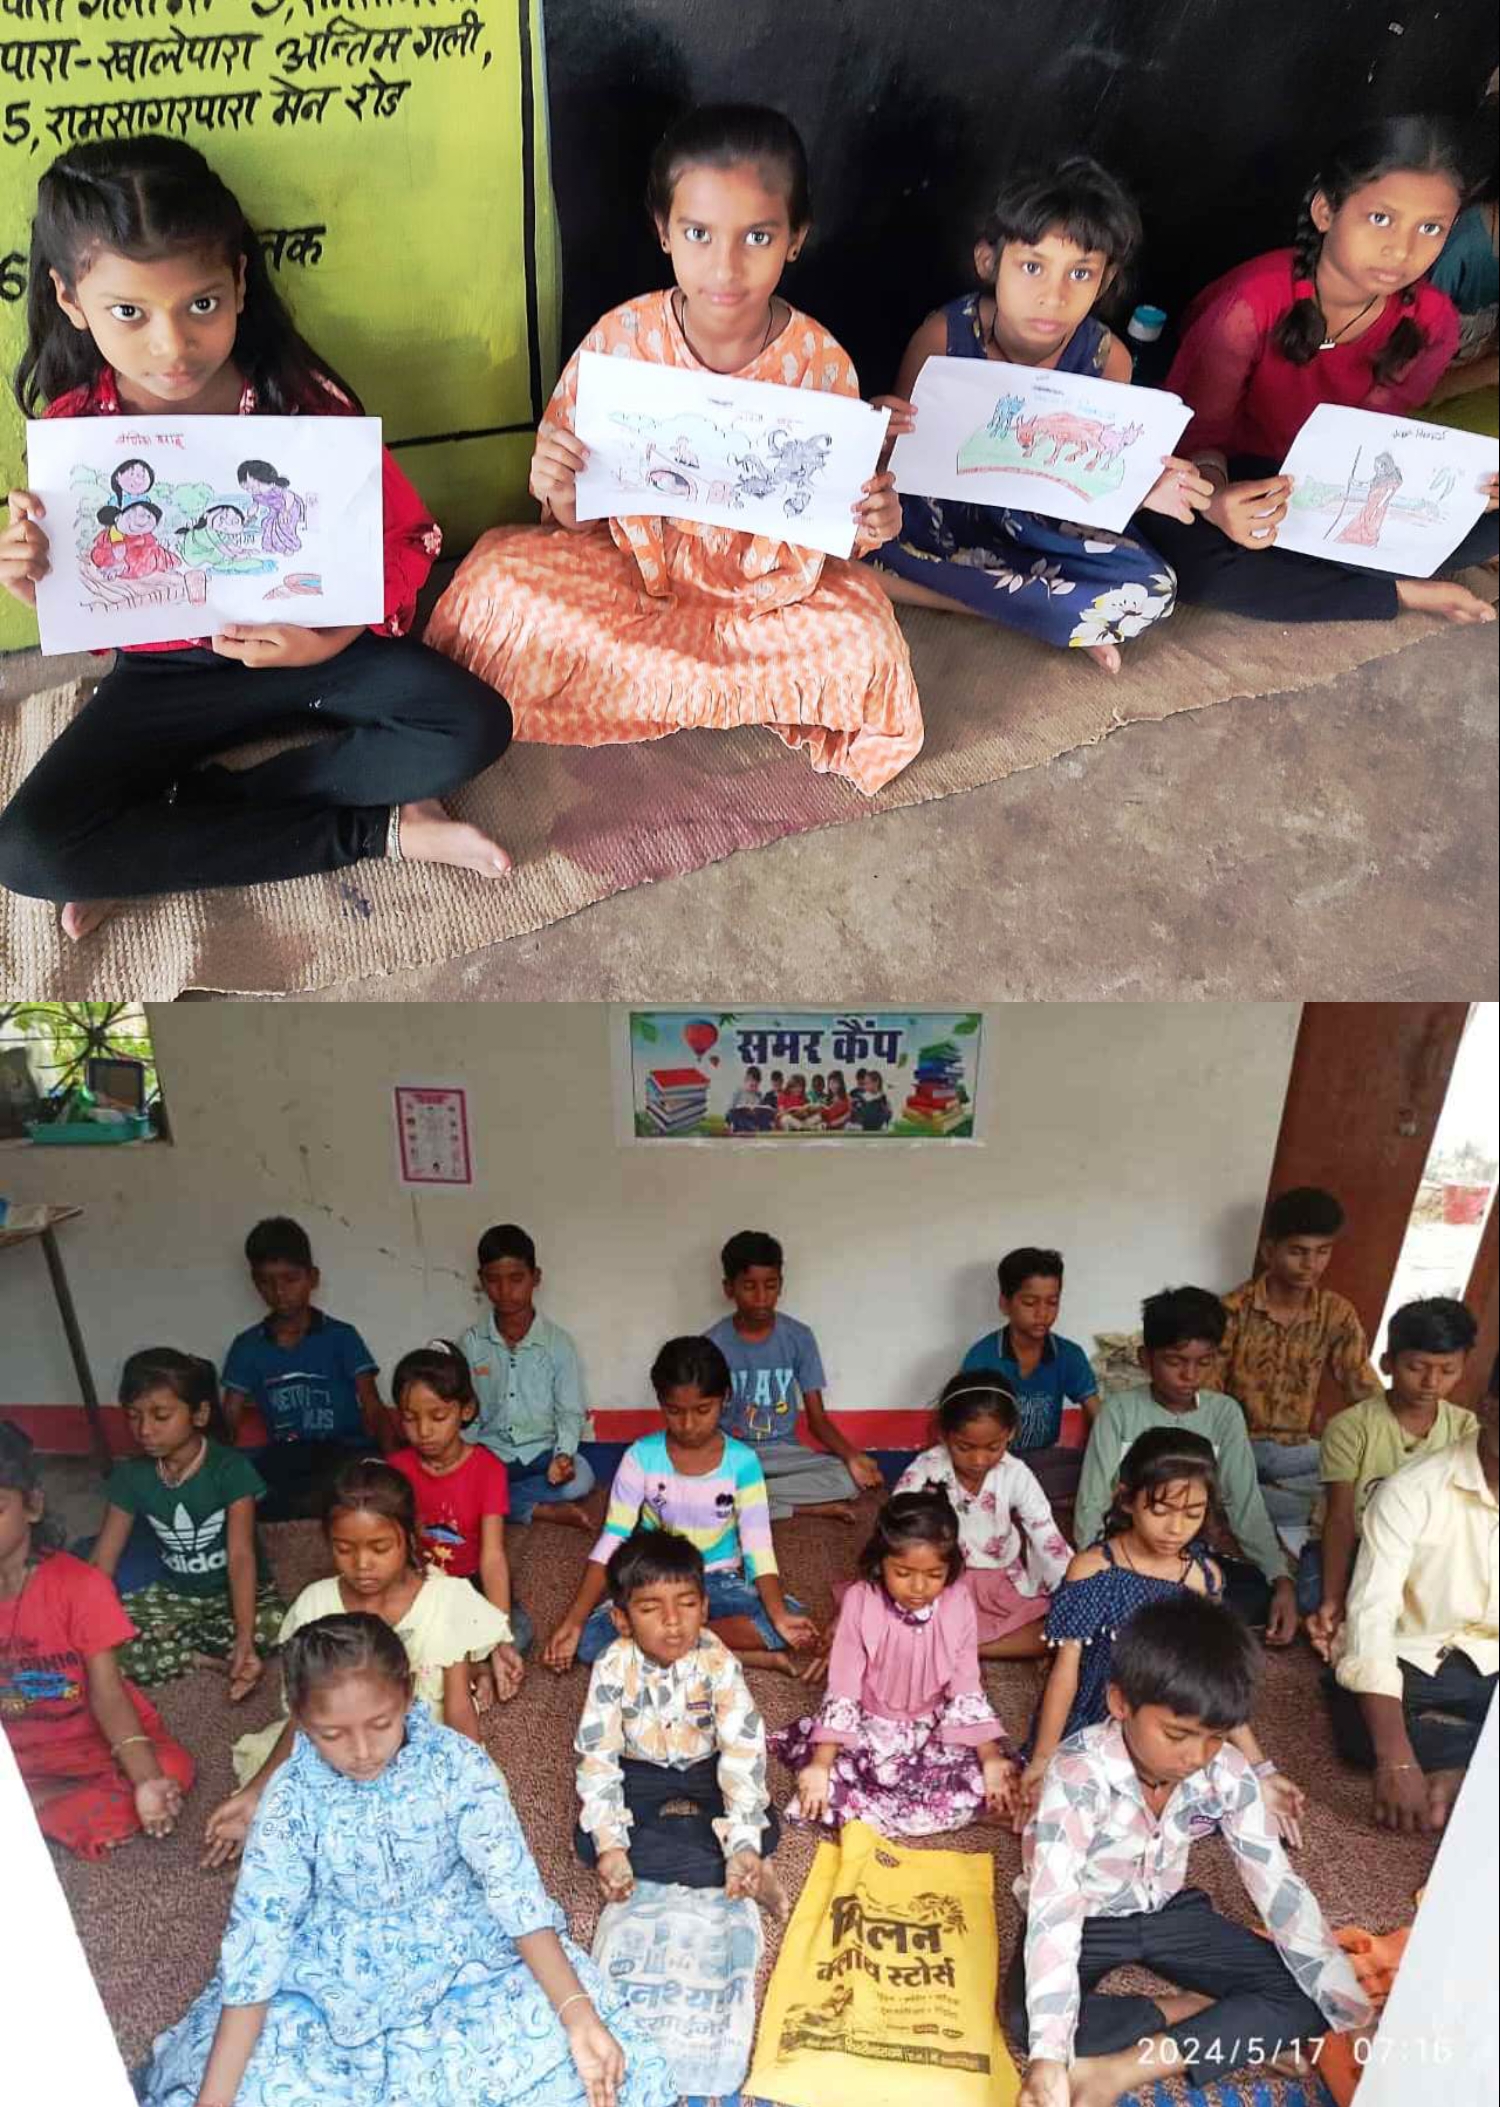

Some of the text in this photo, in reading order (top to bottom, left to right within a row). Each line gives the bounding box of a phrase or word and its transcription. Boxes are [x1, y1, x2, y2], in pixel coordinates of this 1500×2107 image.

[412, 9, 493, 70] गली,
[269, 75, 342, 126] मेन
[737, 1018, 904, 1065] समर कैंप
[831, 1893, 942, 1954] मिलन
